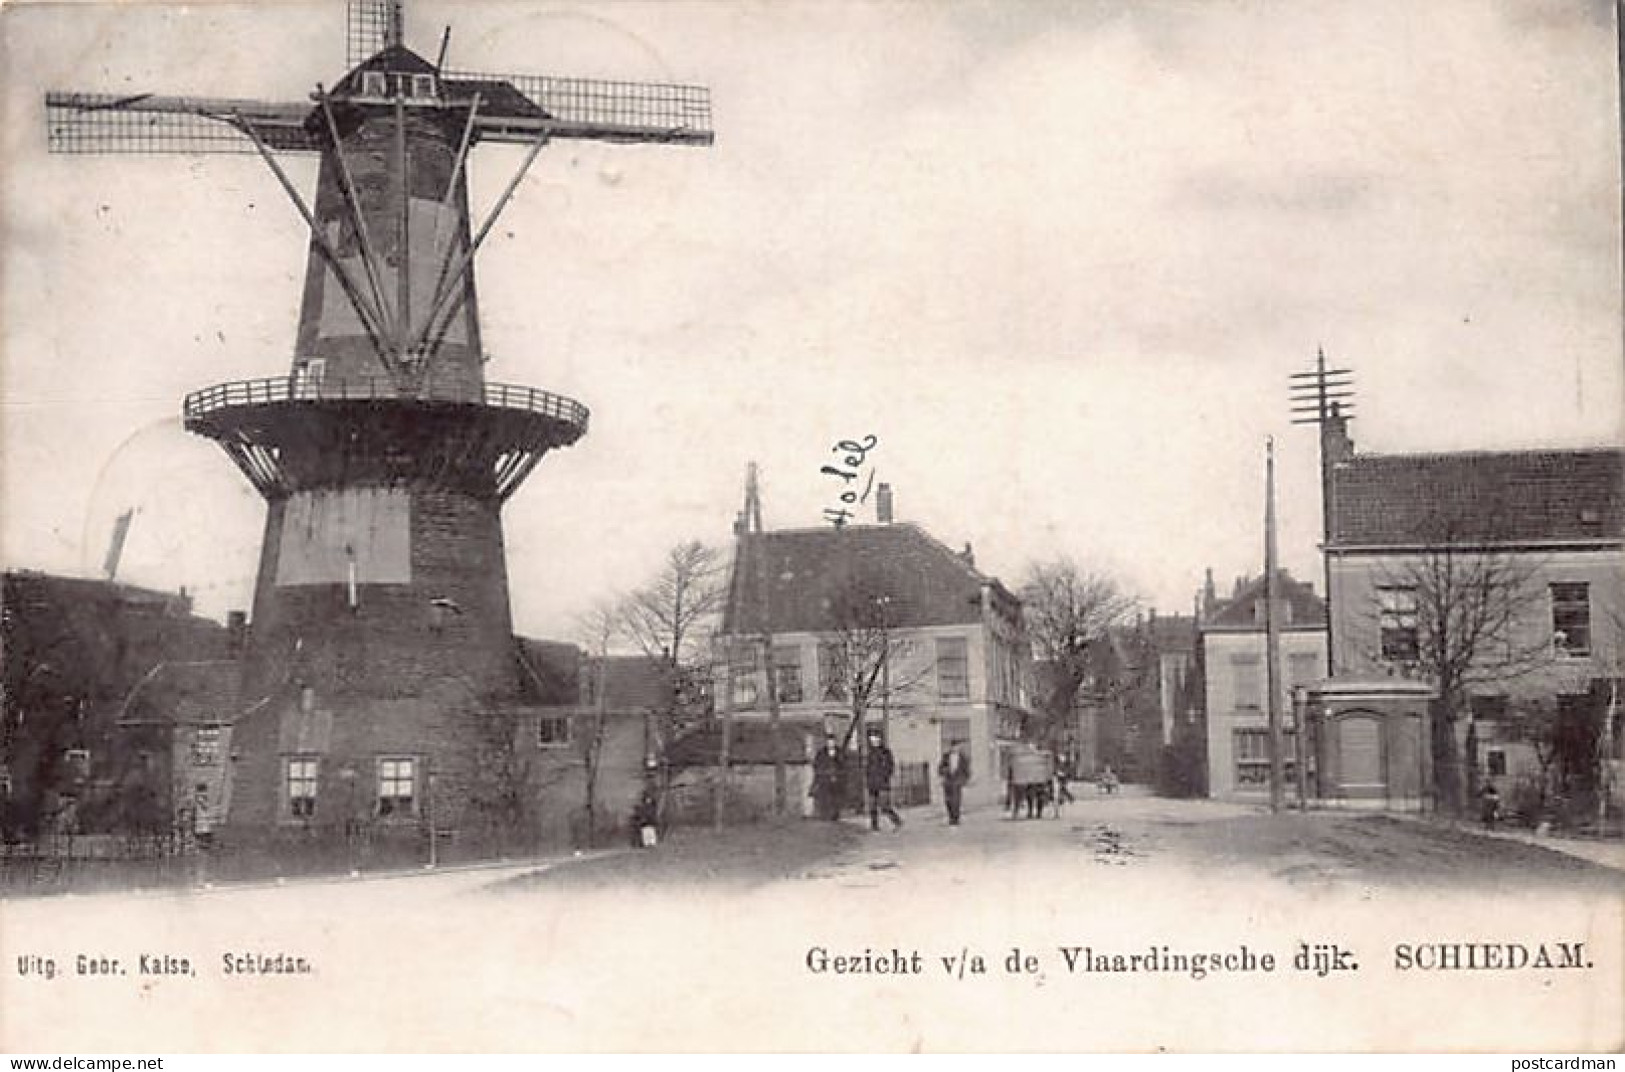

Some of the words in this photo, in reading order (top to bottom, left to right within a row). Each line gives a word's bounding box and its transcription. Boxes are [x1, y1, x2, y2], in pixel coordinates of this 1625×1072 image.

[805, 946, 922, 975] Gezicht
[941, 948, 987, 980] v/a
[1005, 948, 1039, 974] de
[1059, 945, 1276, 980] Vlaardingsche
[1294, 942, 1359, 977] dijk.
[1395, 942, 1594, 971] SCHIEDAM.
